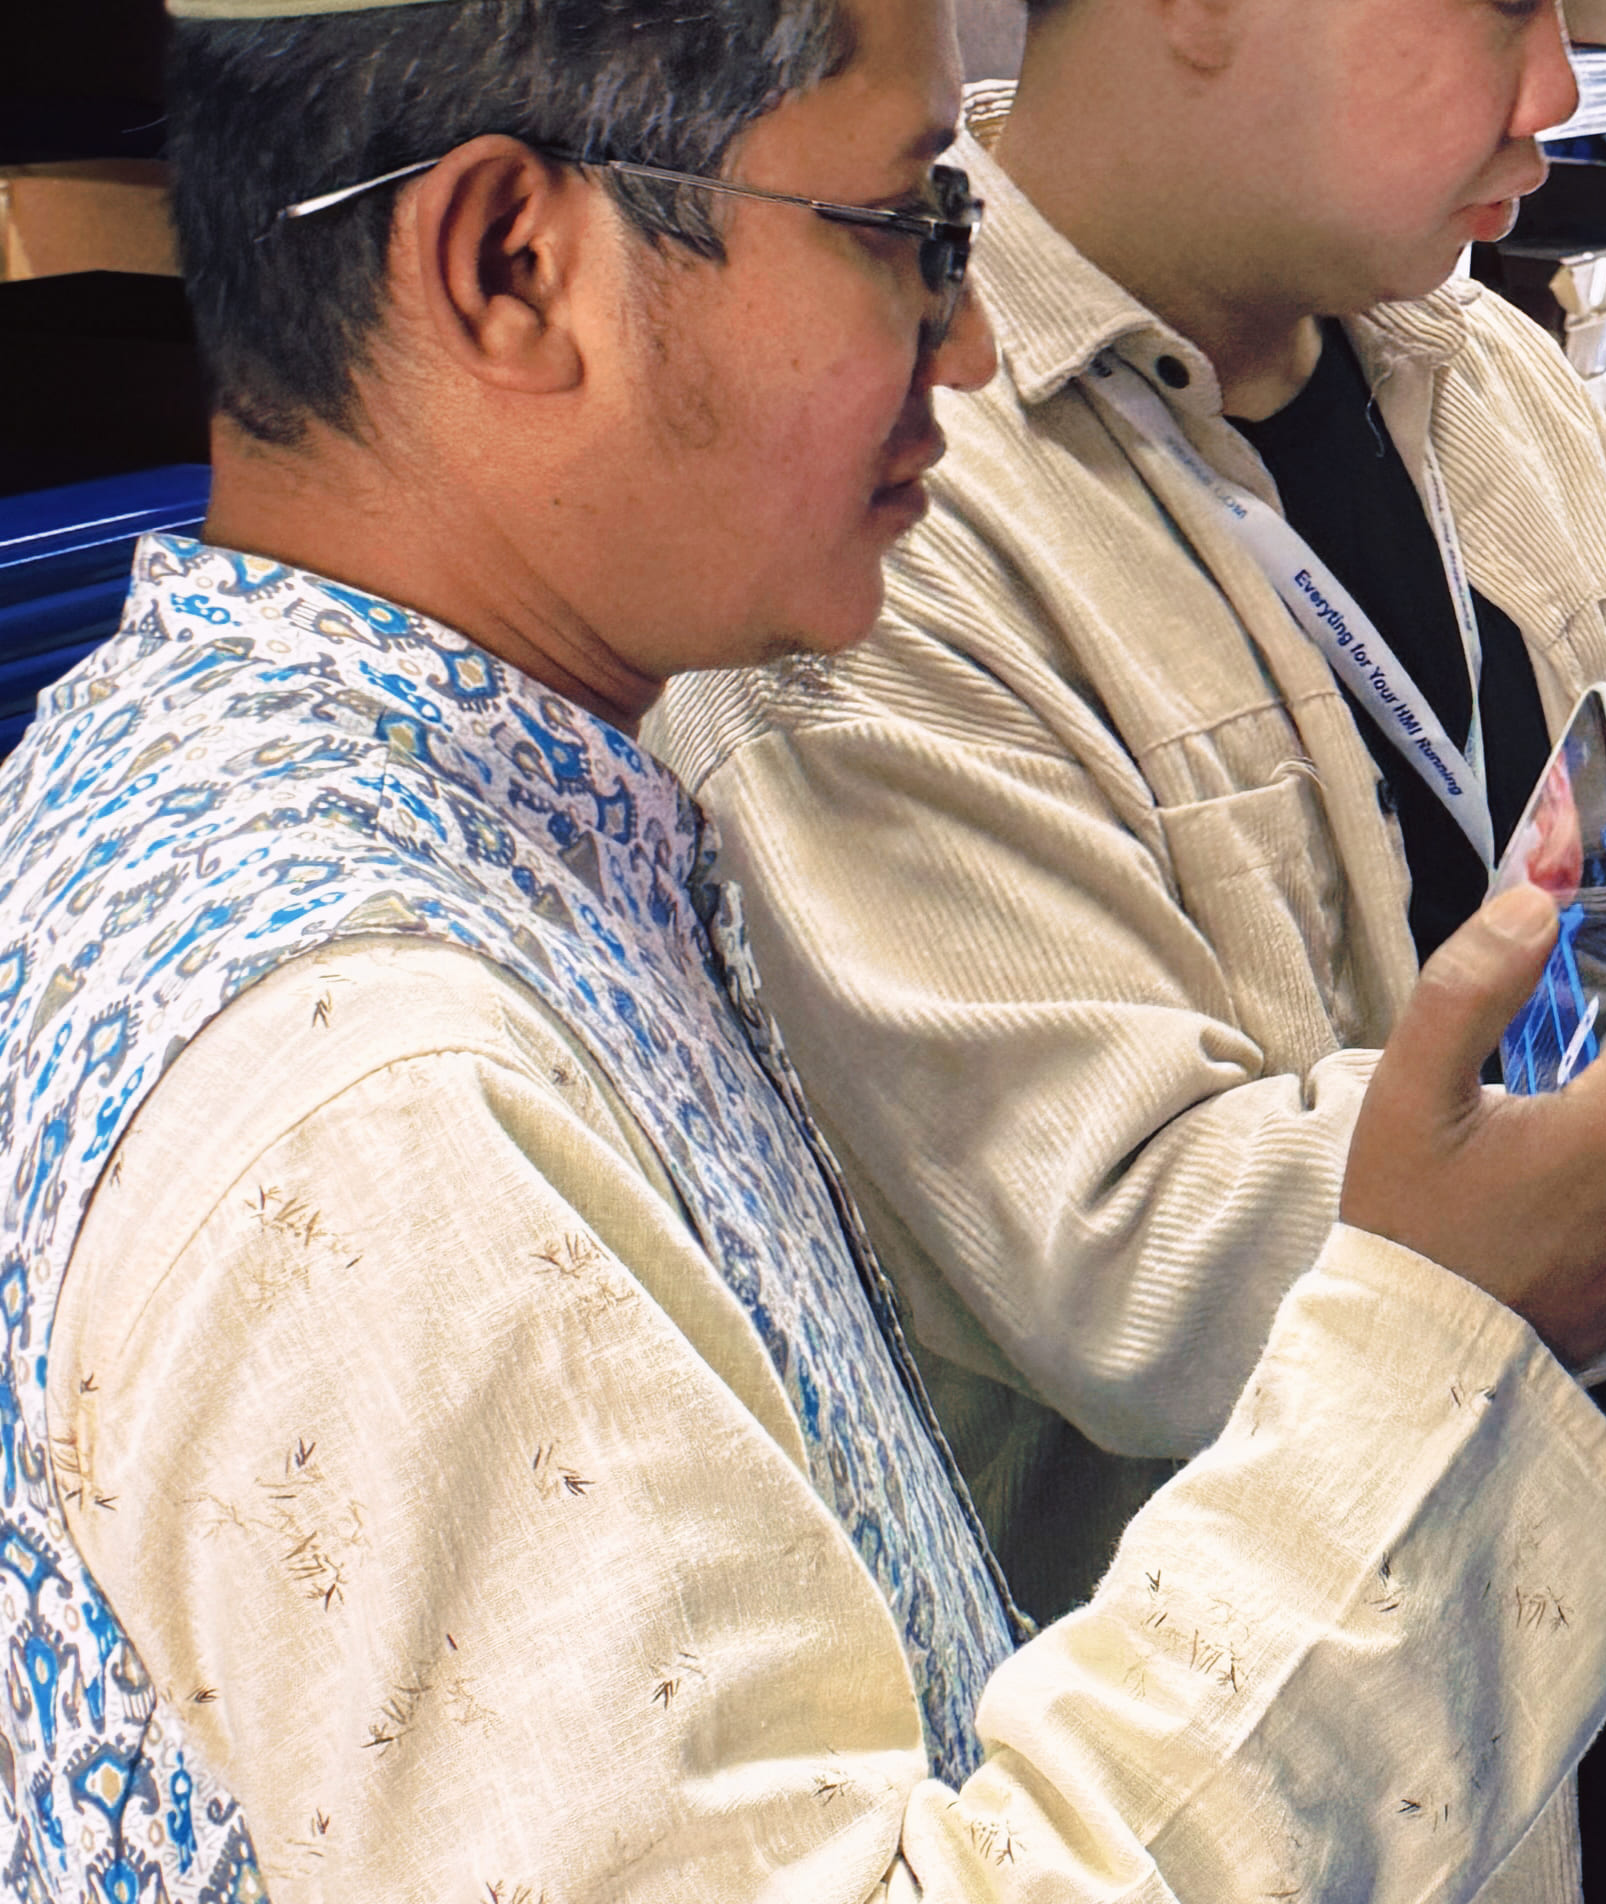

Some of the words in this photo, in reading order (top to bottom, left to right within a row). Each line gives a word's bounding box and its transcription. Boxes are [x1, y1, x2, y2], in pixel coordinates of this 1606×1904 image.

[1349, 642, 1373, 668] for
[1368, 665, 1399, 705] Your
[1392, 703, 1424, 737] HMI
[1415, 735, 1464, 797] Running
